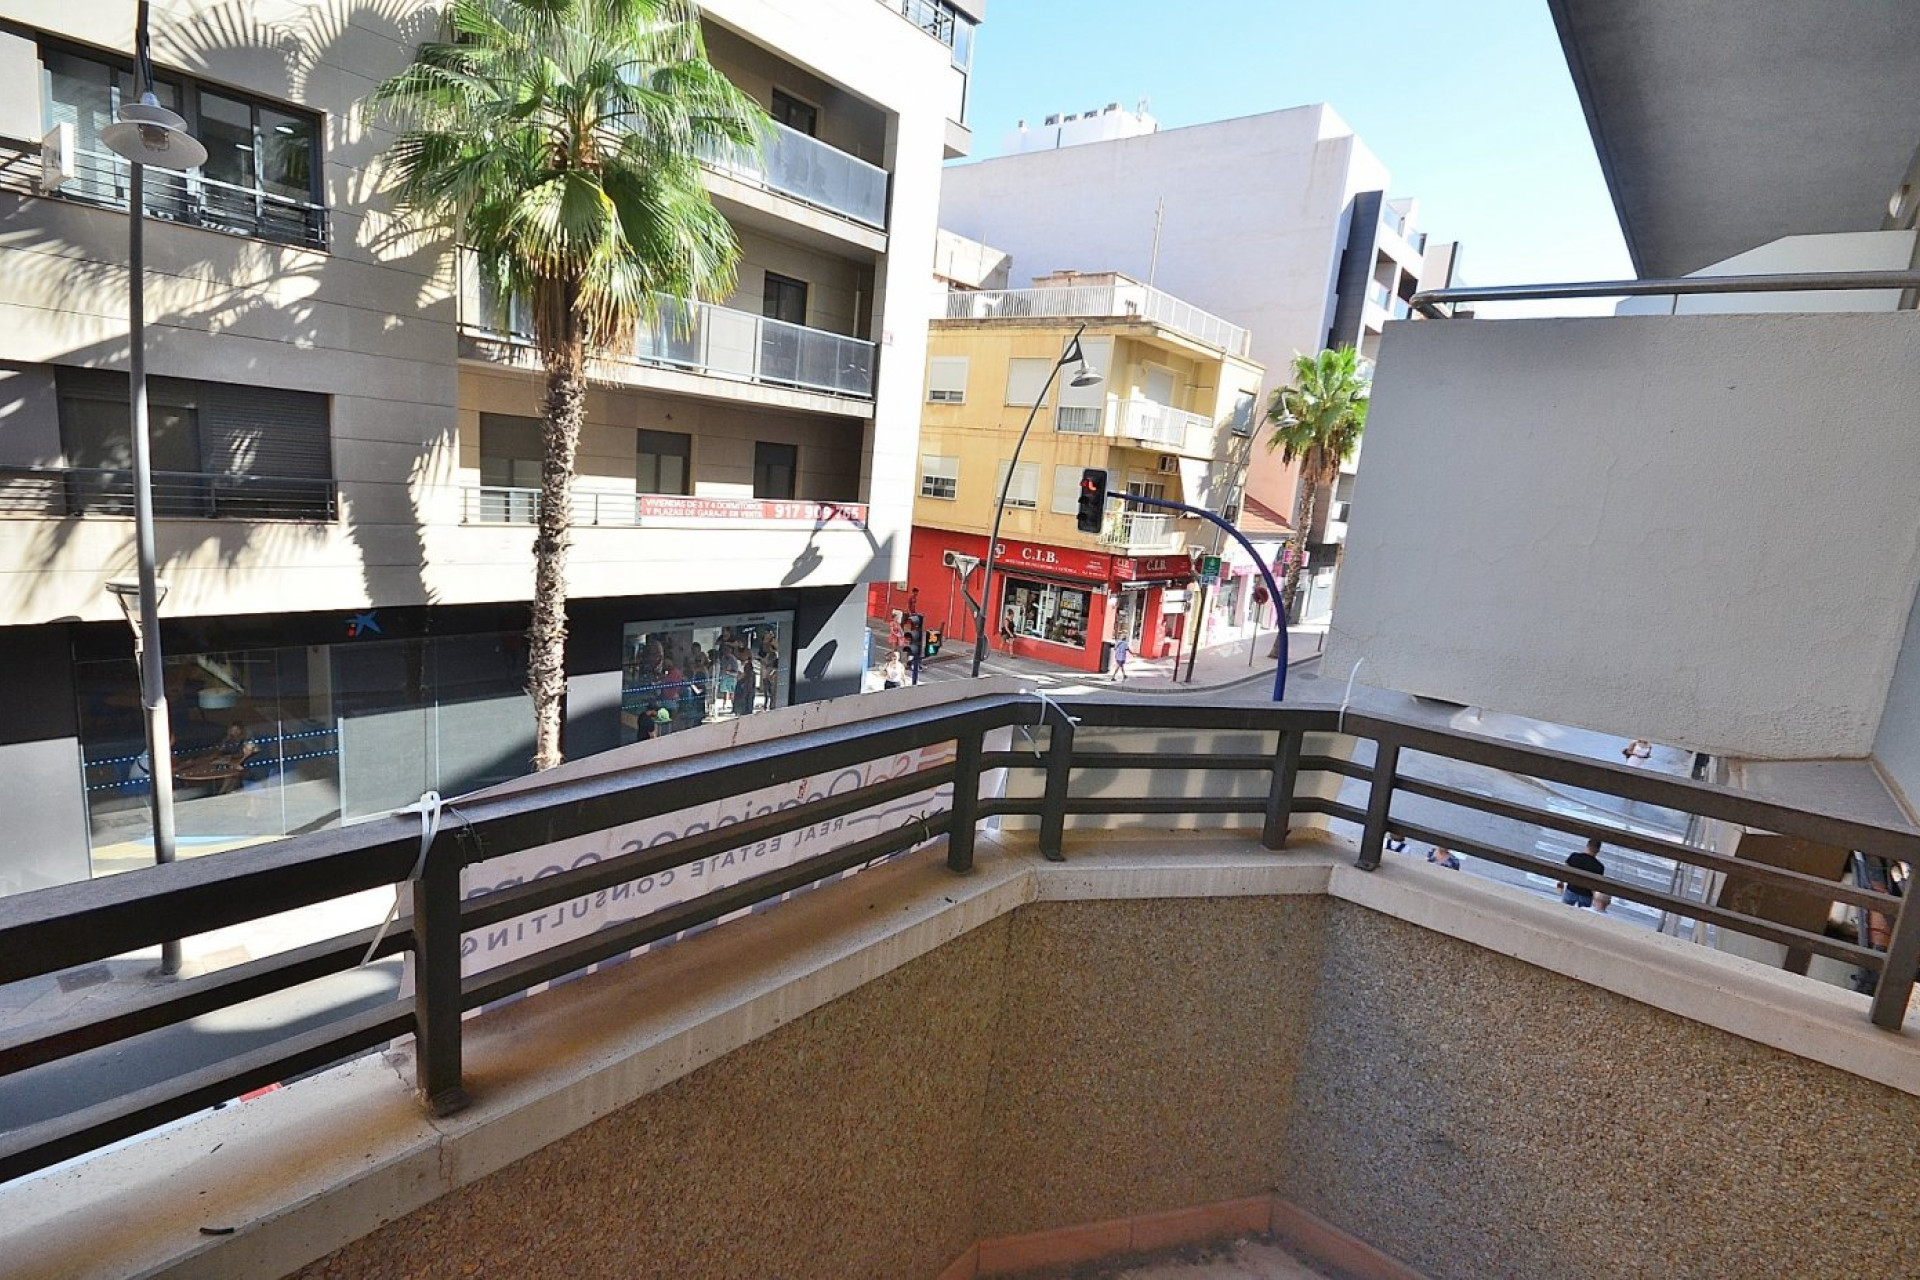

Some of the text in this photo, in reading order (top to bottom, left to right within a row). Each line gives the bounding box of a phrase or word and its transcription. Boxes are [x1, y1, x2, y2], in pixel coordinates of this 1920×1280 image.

[653, 508, 684, 516] PLAZAS
[686, 508, 697, 517] DE
[775, 503, 800, 519] 917
[805, 503, 832, 520] 909
[1022, 547, 1059, 564] C.I.B.
